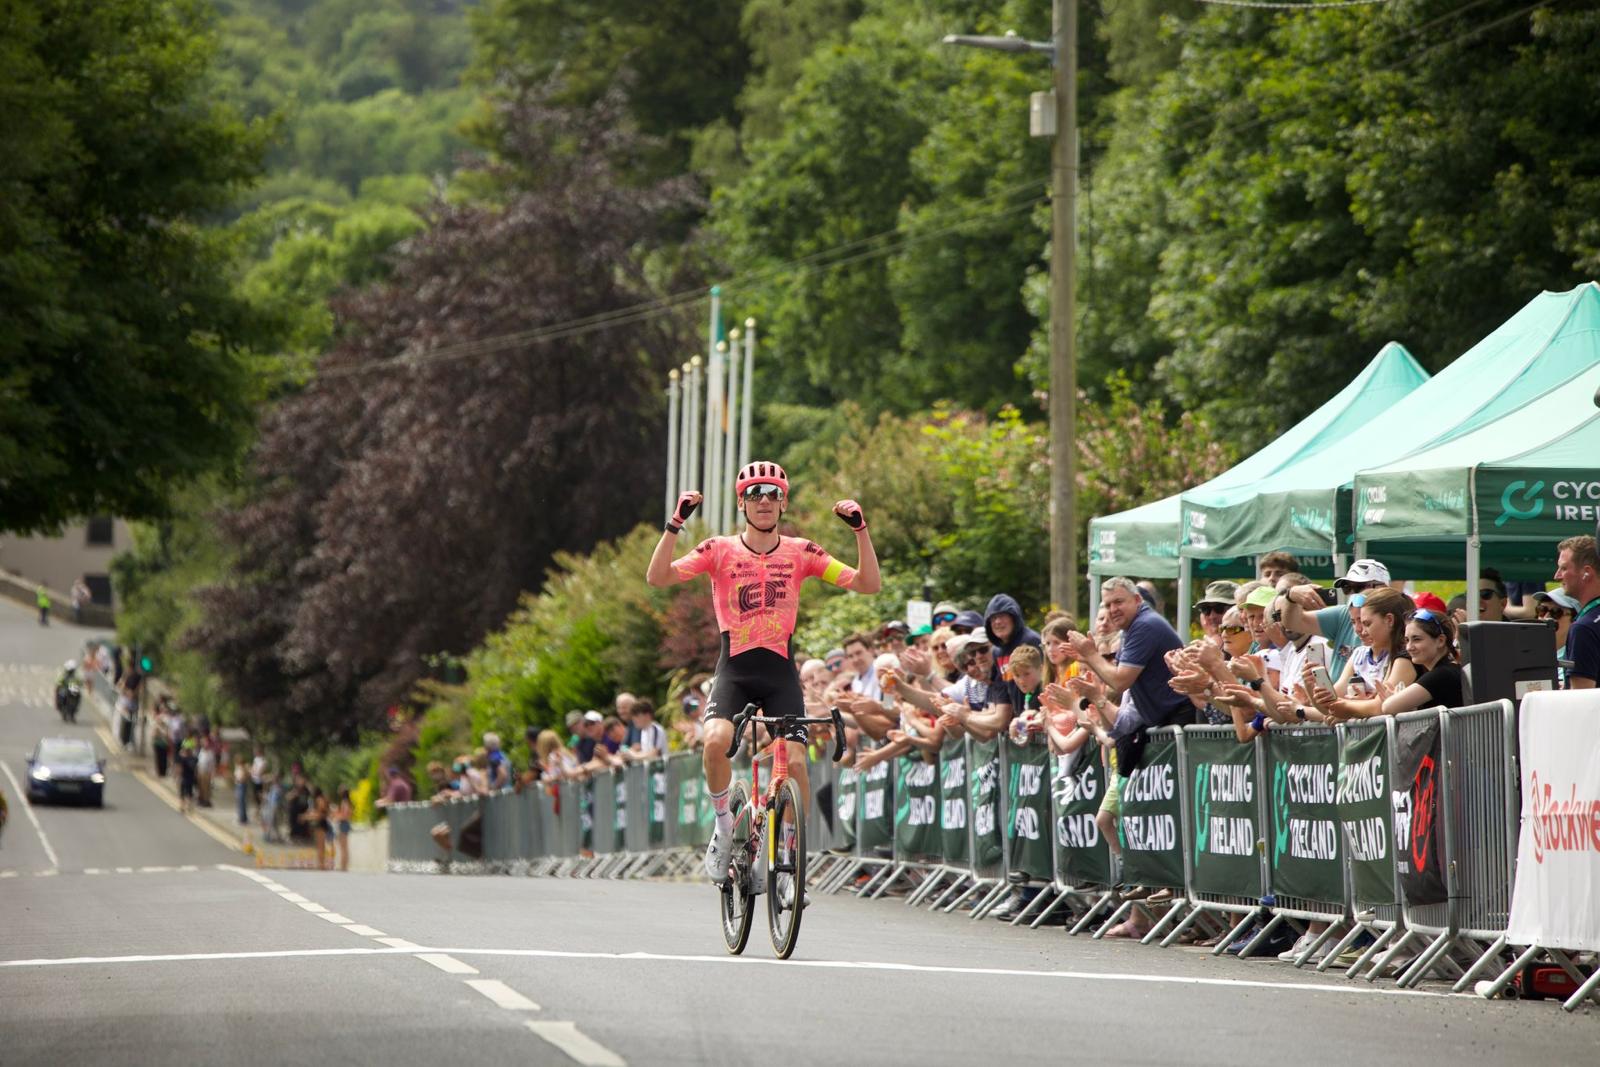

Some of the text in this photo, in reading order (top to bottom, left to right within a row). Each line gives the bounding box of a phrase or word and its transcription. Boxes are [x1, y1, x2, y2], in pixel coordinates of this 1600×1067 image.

[1552, 481, 1600, 500] CYC
[1210, 764, 1254, 803] CYCLING
[1287, 763, 1335, 804] CYCLING
[1210, 816, 1254, 857] IRELAND
[1289, 818, 1337, 861] IRELAND
